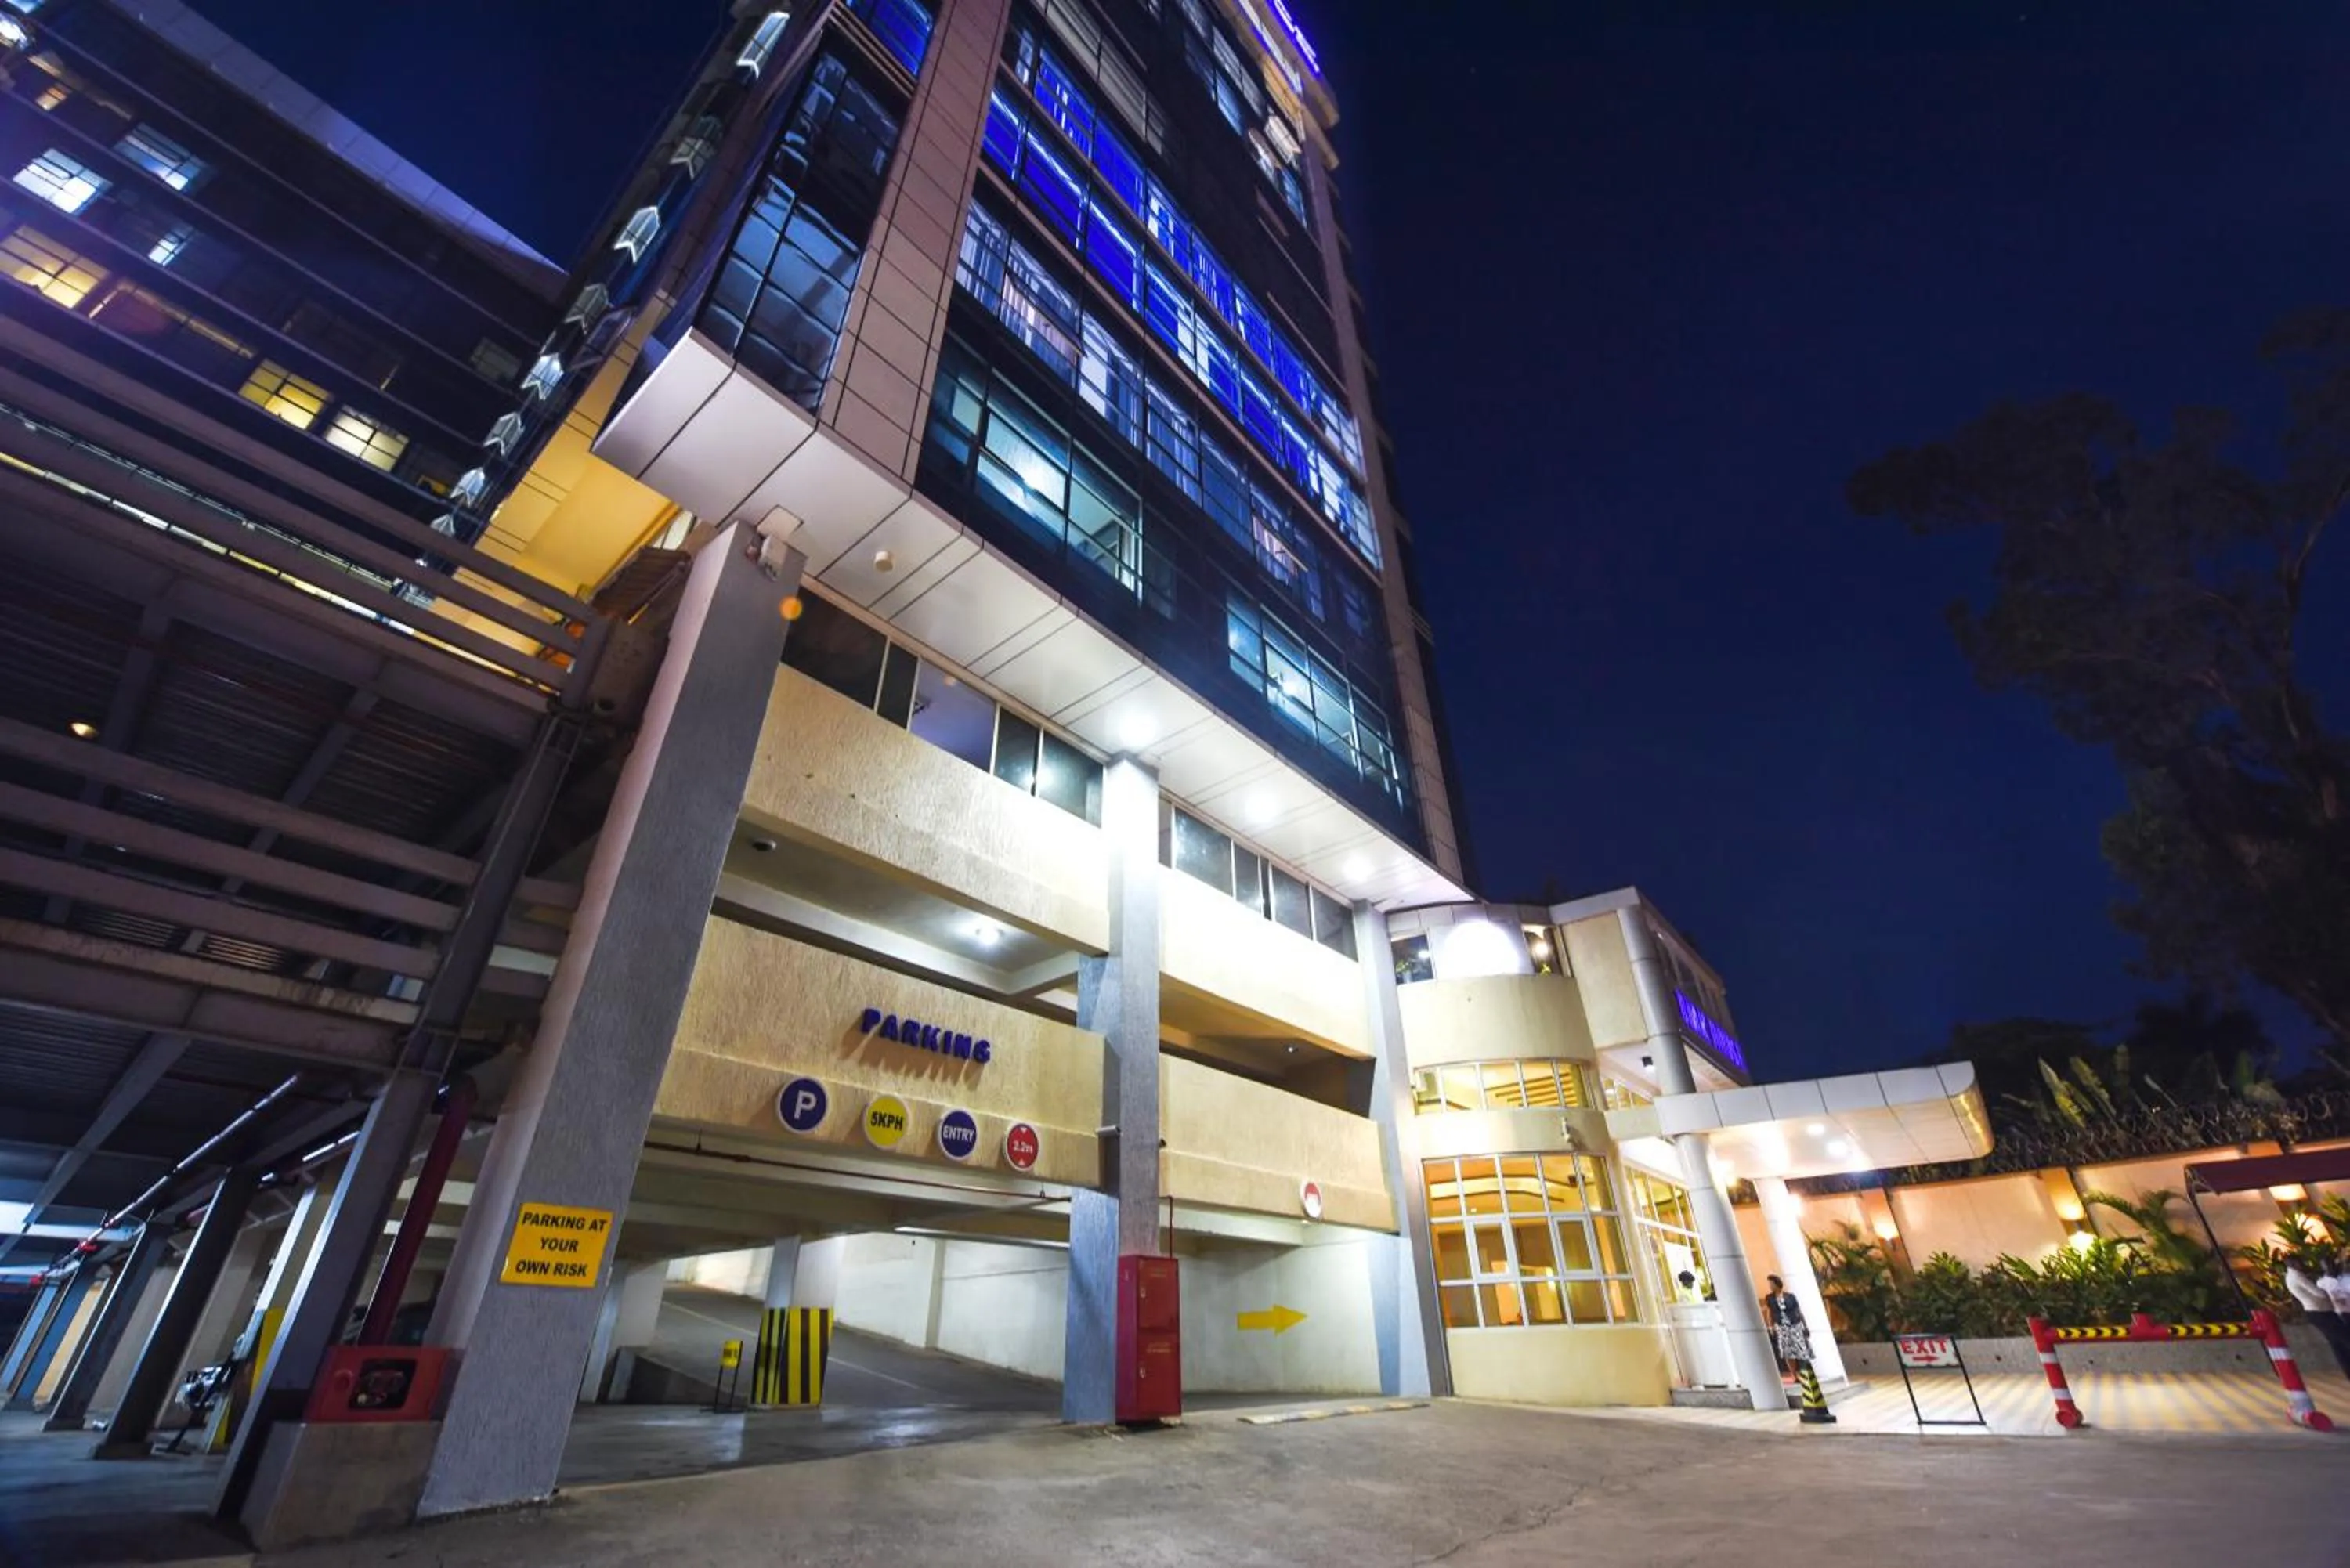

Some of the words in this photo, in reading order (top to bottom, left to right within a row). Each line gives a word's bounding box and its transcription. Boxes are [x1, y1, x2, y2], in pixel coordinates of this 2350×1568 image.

[860, 1008, 990, 1064] PARKING
[794, 1089, 817, 1119] P
[870, 1111, 904, 1131] 5KPH
[942, 1125, 975, 1142] ENTRY
[522, 1212, 585, 1230] PARKING
[588, 1219, 608, 1232] AT
[540, 1237, 579, 1253] YOUR
[515, 1259, 551, 1277] OWN
[553, 1263, 588, 1277] RISK
[1901, 1338, 1947, 1354] EXIT
